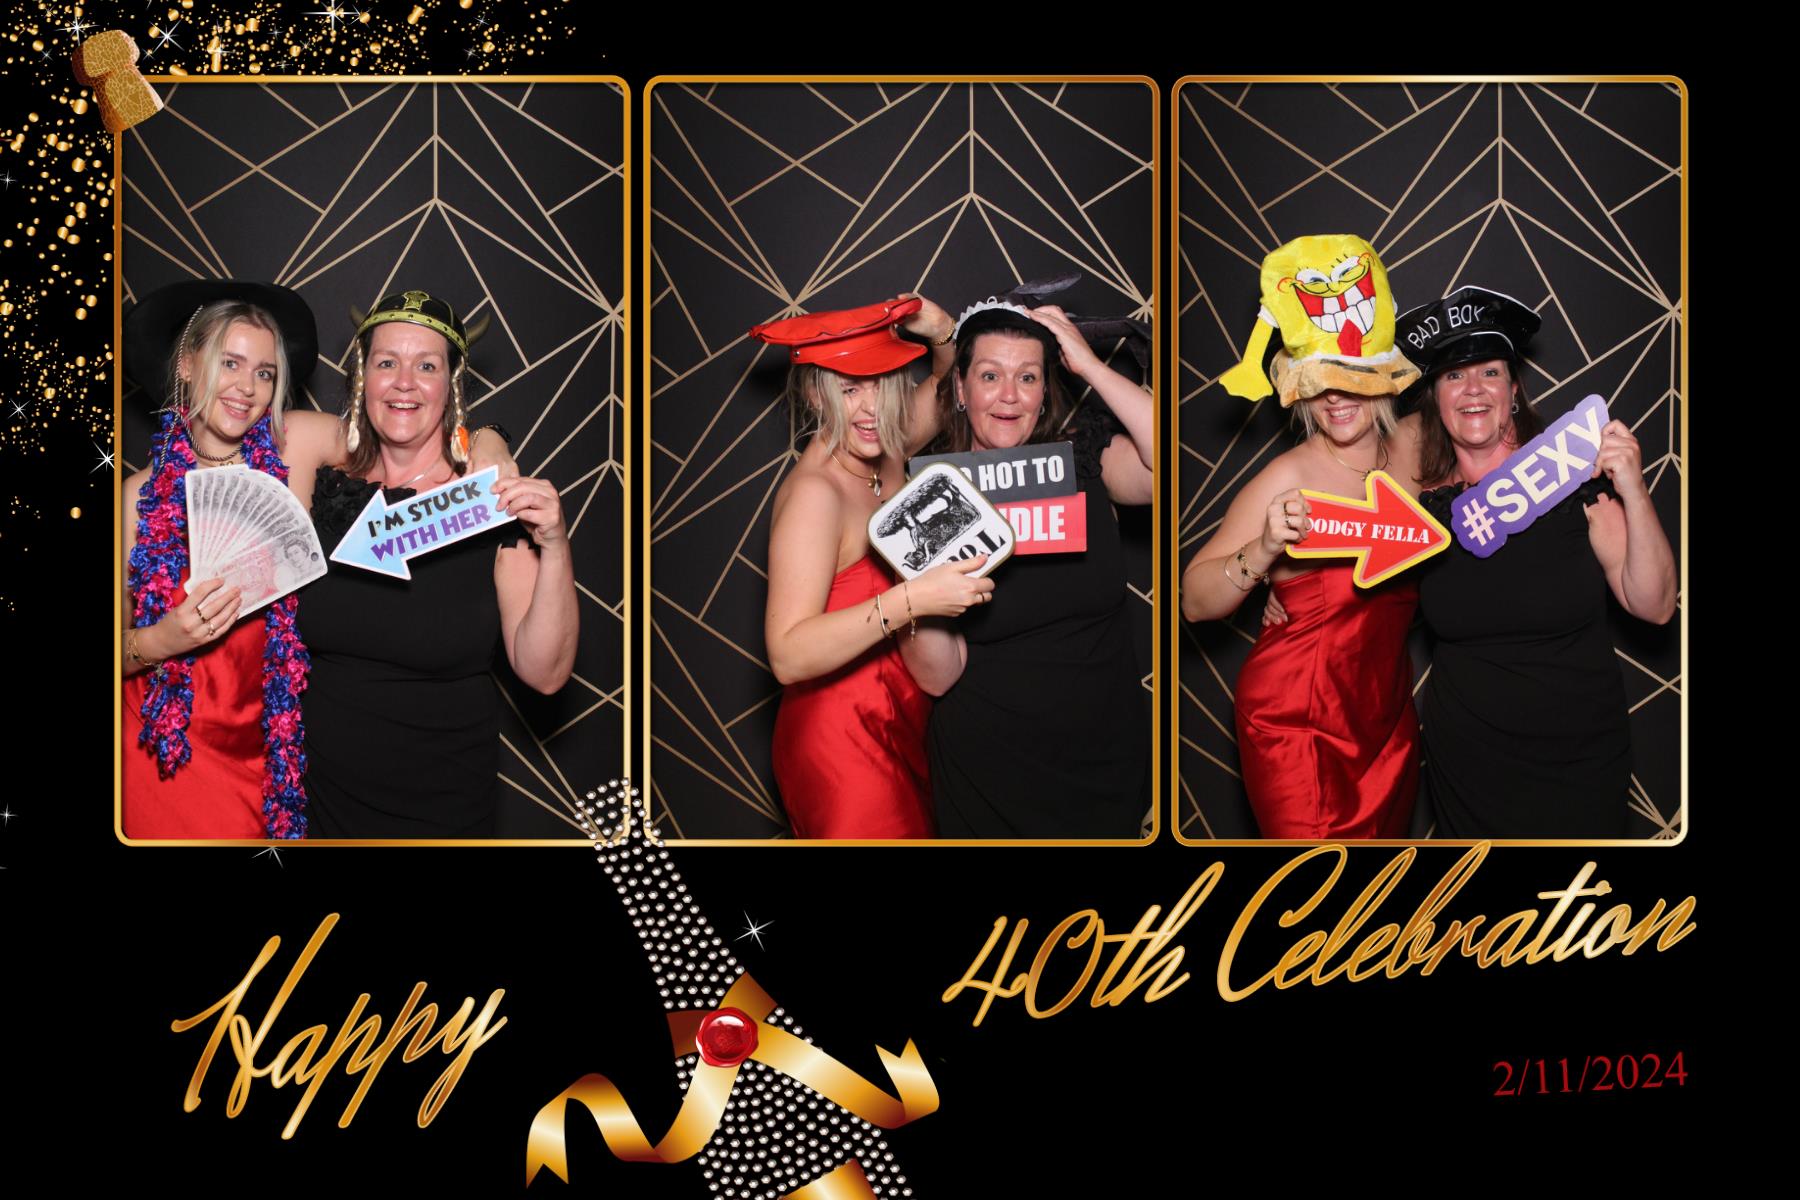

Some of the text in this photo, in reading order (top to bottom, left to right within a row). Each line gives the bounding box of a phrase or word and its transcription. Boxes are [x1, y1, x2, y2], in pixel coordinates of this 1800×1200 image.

[1408, 304, 1485, 349] BAD BOY
[978, 460, 1027, 492] HOT
[1032, 455, 1065, 484] TO
[1462, 406, 1602, 547] #SEXY
[367, 481, 482, 538] I'M STUCK
[999, 505, 1065, 542] DLE
[370, 504, 492, 562] WITH HER
[1371, 523, 1430, 544] FELLA
